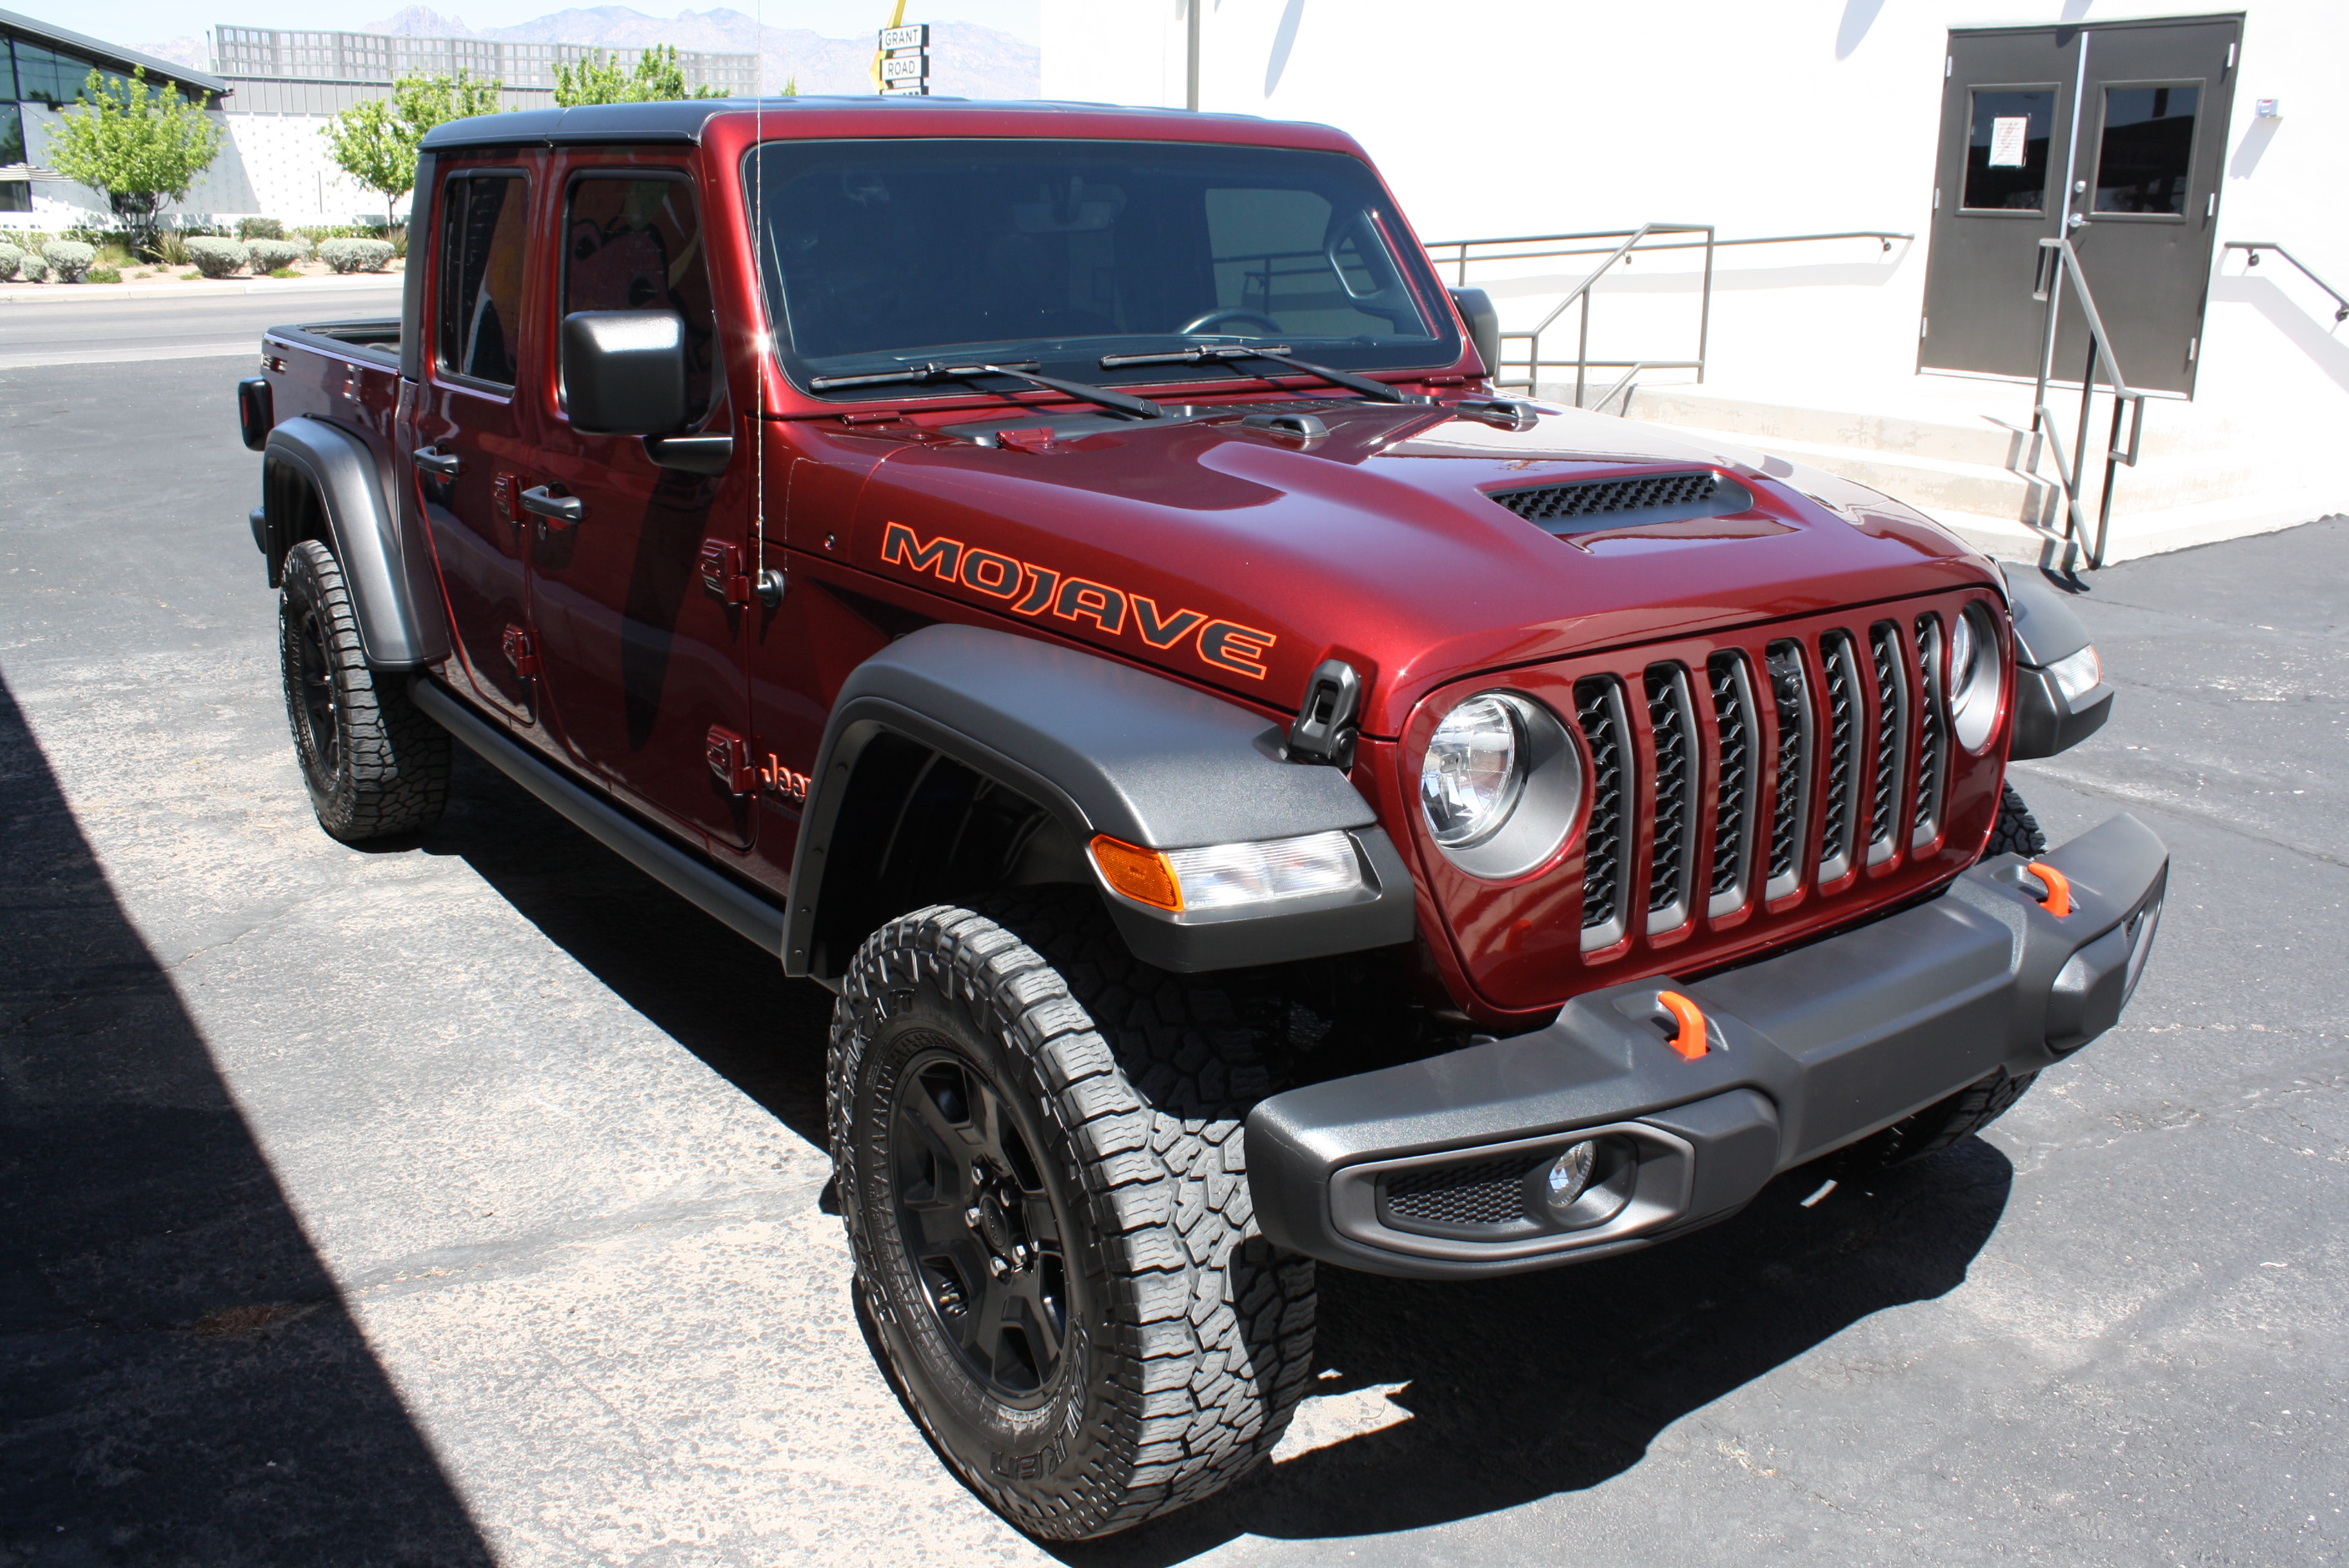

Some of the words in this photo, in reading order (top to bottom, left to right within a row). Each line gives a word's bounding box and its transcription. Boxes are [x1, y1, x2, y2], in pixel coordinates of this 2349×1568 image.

[885, 29, 918, 46] GRANT
[888, 60, 915, 76] ROAD
[880, 520, 1277, 681] MOJAVE
[760, 753, 812, 803] Jee
